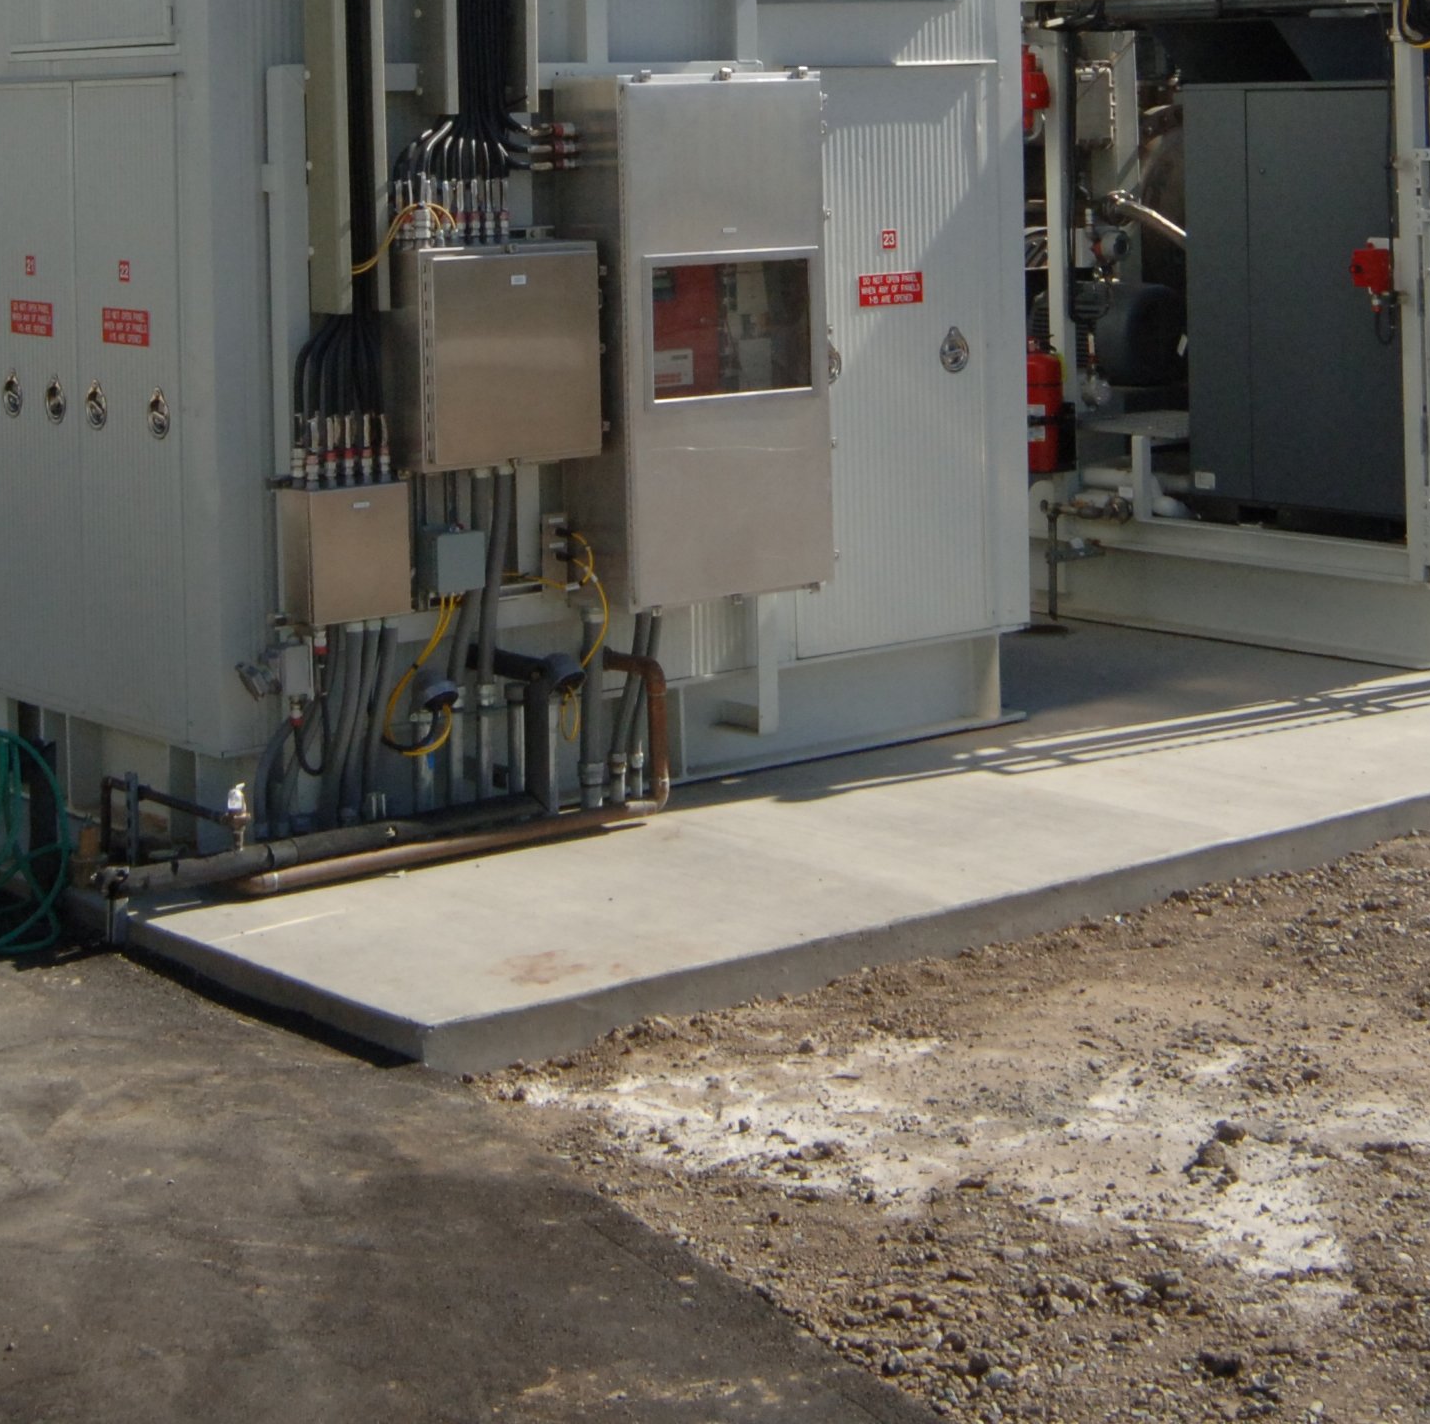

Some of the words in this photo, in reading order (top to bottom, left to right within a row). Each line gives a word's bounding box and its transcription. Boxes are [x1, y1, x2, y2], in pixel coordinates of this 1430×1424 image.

[883, 233, 895, 246] 23
[27, 259, 35, 272] 21
[120, 264, 129, 278] 22
